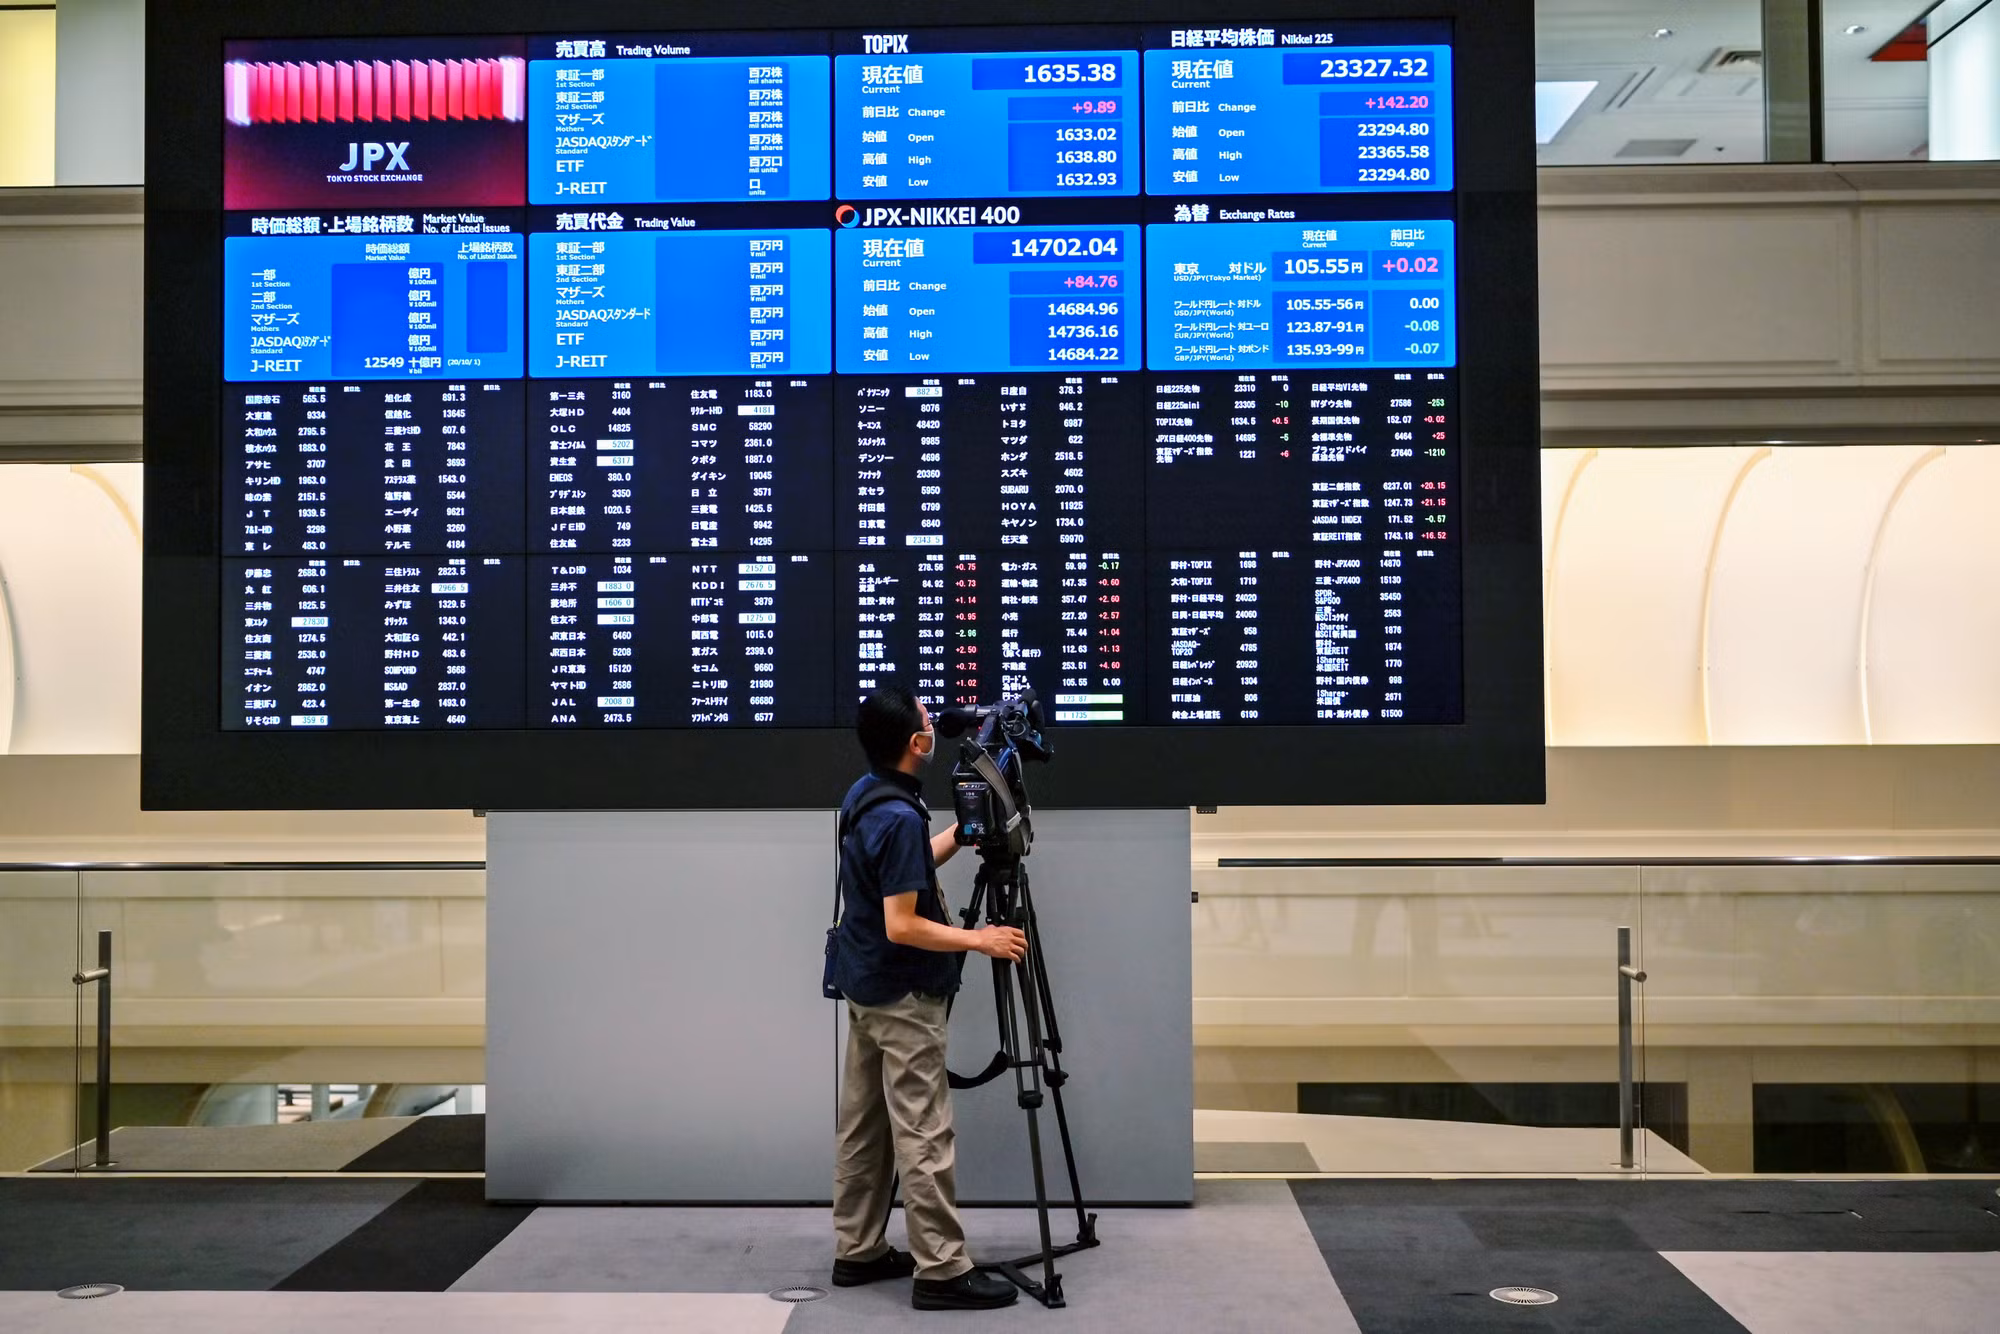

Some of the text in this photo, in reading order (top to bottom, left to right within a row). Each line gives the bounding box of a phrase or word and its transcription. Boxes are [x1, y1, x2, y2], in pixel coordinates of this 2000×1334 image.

[1172, 28, 1274, 47] 日経平均株価
[1315, 34, 1333, 44] 225
[556, 40, 606, 58] 売買高
[863, 35, 908, 53] TOPIX
[616, 45, 690, 57] Trading Volume
[749, 67, 782, 78] 百万株
[1025, 64, 1115, 82] 1635.38
[1172, 60, 1233, 79] 現在値
[1321, 58, 1428, 77] 23327.32
[556, 69, 604, 81] 東証一部
[862, 65, 923, 84] 現在値
[1172, 80, 1210, 88] Current
[556, 91, 604, 103] 東証二部
[1366, 96, 1428, 108] +142.20
[863, 106, 945, 118] 前日比 Change
[1073, 101, 1116, 114] +9.89
[1172, 101, 1256, 113] 前日比 Change
[556, 113, 604, 125] マザーズ
[1056, 128, 1116, 141] 1633.02
[1218, 129, 1244, 138] Open
[1358, 123, 1429, 136] 23294.80
[862, 130, 934, 143] 始値 Open
[339, 142, 409, 171] JPX
[1057, 150, 1116, 163] 1638.80
[1219, 151, 1242, 160] High
[1359, 146, 1429, 158] 23365.58
[863, 153, 931, 165] 高値 High
[557, 160, 584, 172] ETF
[1057, 173, 1116, 186] 1632.93
[1359, 168, 1429, 181] 23294.80
[863, 176, 887, 187] 安値
[556, 182, 607, 194] J-REIT
[423, 213, 485, 224] Market Value
[863, 206, 1020, 226] JPX-NIKKEI 400
[1174, 204, 1209, 222] 為替
[1220, 209, 1295, 221] Exchange Rates
[556, 212, 624, 230] 売買代金
[634, 217, 695, 229] Trading Value
[423, 223, 510, 233] No. of Listed Issues
[1303, 230, 1337, 241] 現在値
[1391, 229, 1424, 240] 前日比
[366, 243, 410, 254] 時価総額
[458, 242, 513, 253] 上場銘柄数
[556, 242, 604, 254] 東証一部
[750, 240, 783, 251] 百万円
[864, 238, 924, 258] 現在値
[1012, 238, 1117, 256] 14702.04
[863, 259, 901, 267] Current
[1174, 262, 1266, 275] 東京 対ドル
[1383, 258, 1438, 272] +0.02
[252, 269, 276, 280] 一部
[408, 268, 430, 278] 億円
[556, 264, 604, 276] 東証二部
[864, 280, 946, 292] 前日比 Change
[1064, 275, 1118, 288] +84.76
[252, 291, 275, 303] 二部
[556, 286, 604, 298] マザーズ
[1048, 303, 1118, 315] 14684.96
[1174, 300, 1261, 309] ワールド円レート 対ドル
[1410, 298, 1439, 308] 0.00
[864, 304, 888, 316] 始値
[1048, 325, 1118, 338] 14736.16
[1405, 320, 1439, 331] -0.08
[864, 327, 888, 338] 高値
[557, 333, 584, 345] ETF
[1049, 348, 1118, 360] 14684.22
[1405, 343, 1439, 354] -0.07
[864, 349, 888, 361] 安値
[250, 360, 302, 372] J-REIT
[365, 357, 404, 368] 12549
[556, 355, 608, 368] J-REIT
[1234, 384, 1255, 392] 23310
[612, 391, 631, 399] 3160
[612, 407, 631, 415] 4404
[921, 404, 940, 412] 8076
[1068, 435, 1083, 444] 622
[1240, 450, 1255, 458] 1221
[307, 460, 325, 468] 3707
[750, 471, 772, 479] 19045
[754, 488, 771, 496] 3571
[921, 503, 940, 511] 6799
[1060, 501, 1083, 510] 11925
[617, 522, 631, 530] 749
[613, 565, 631, 574] 1034
[307, 666, 325, 675] 4747
[609, 664, 631, 672] 15120
[755, 713, 773, 721] 6577
[1381, 709, 1402, 717] 51500
